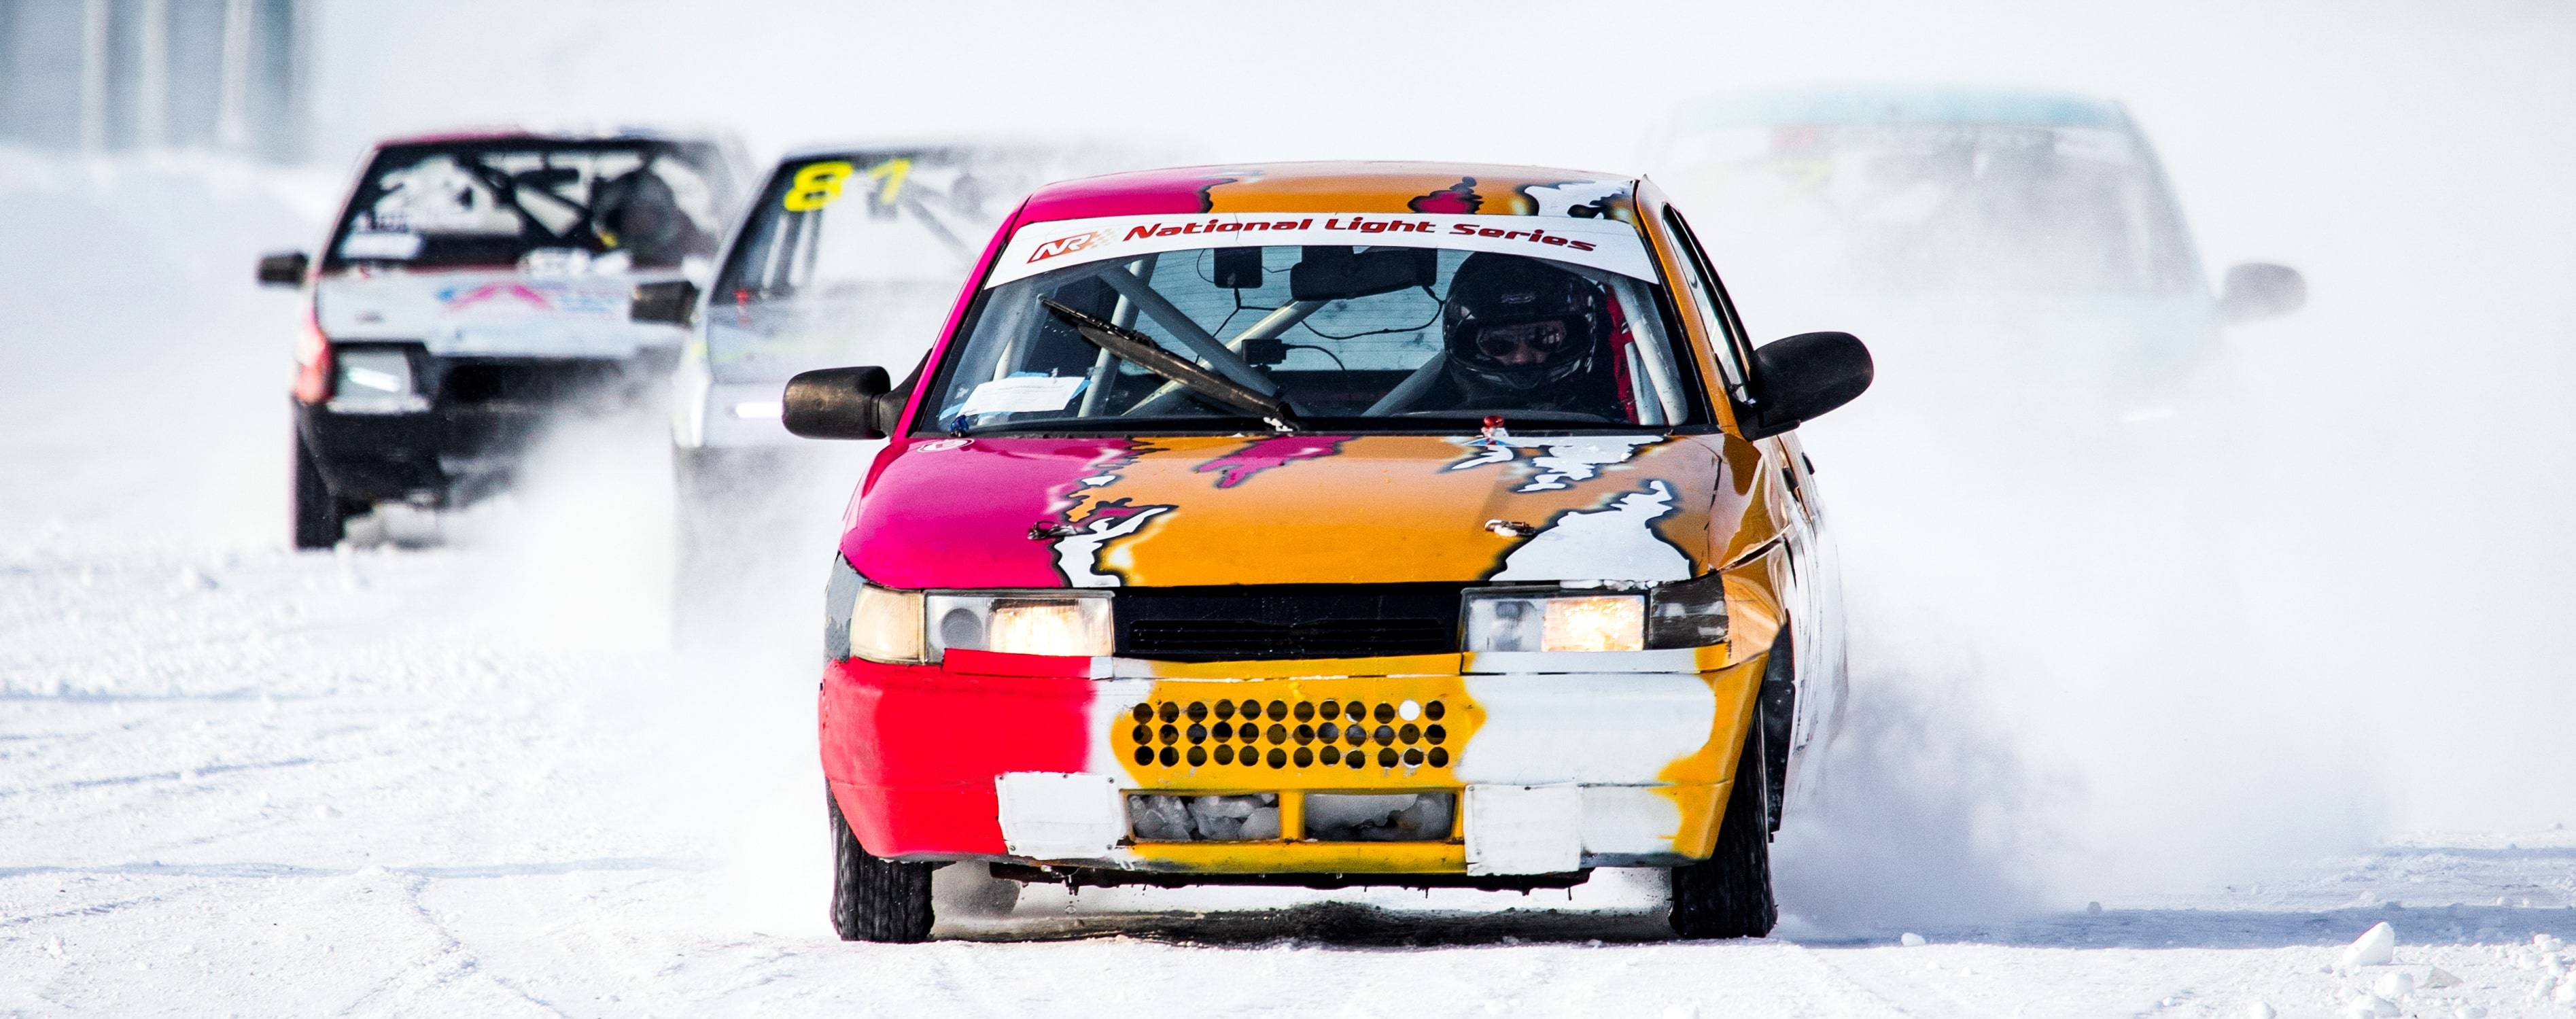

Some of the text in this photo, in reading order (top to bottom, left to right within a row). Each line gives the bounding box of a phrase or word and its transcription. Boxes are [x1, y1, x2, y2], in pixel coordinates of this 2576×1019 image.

[784, 160, 911, 211] 81
[1123, 216, 1597, 252] National Light Series
